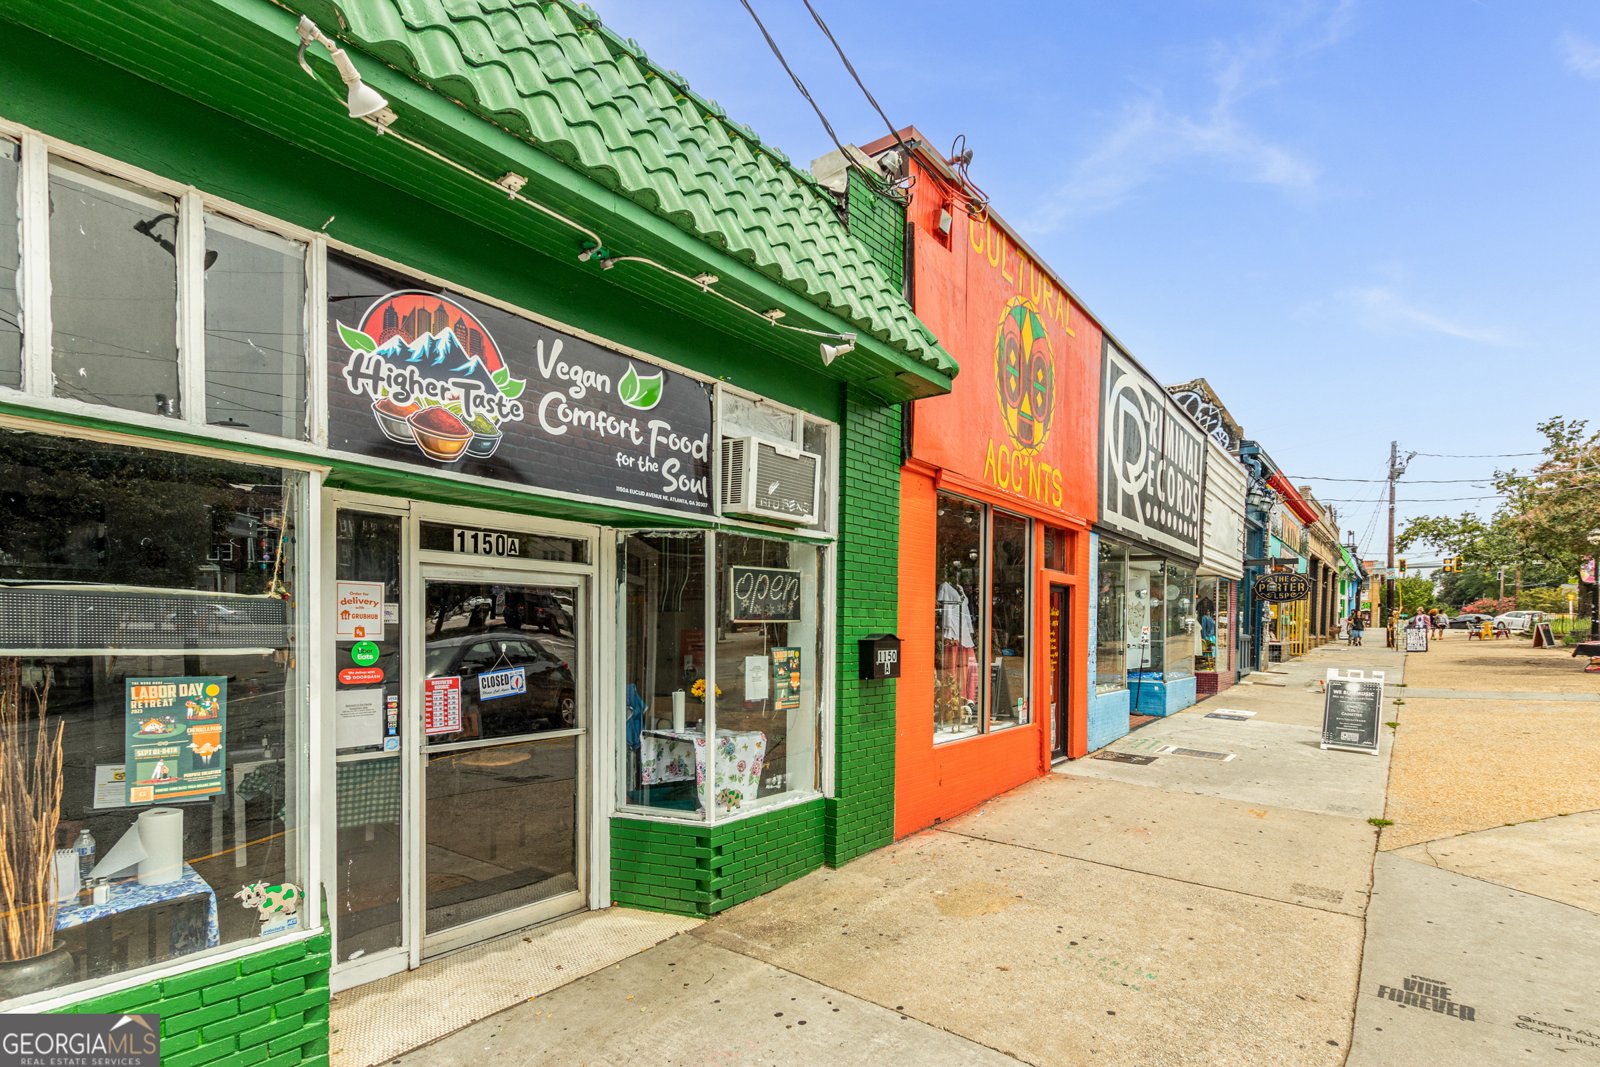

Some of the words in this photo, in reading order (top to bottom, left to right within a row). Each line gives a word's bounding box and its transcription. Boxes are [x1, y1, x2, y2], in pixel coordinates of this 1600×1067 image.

[968, 213, 1076, 338] CULTURAL
[537, 339, 611, 399] Vegan
[344, 351, 452, 404] Higher
[449, 378, 524, 421] Taste
[538, 391, 643, 445] Comfort
[648, 419, 708, 463] Food
[616, 452, 635, 467] for
[637, 456, 659, 472] the
[661, 457, 708, 498] Soul
[983, 437, 1063, 507] ACC'NTS
[629, 488, 645, 497] EUCLID
[646, 492, 662, 500] AVENUE
[670, 497, 688, 505] ATLANTA,
[340, 597, 379, 608] delivery
[735, 572, 799, 614] open
[878, 650, 898, 663] 1150
[885, 662, 891, 674] A
[130, 684, 177, 700] LABOR
[178, 682, 204, 697] DAY
[481, 673, 510, 690] CLOSED
[130, 699, 174, 709] RETREAT
[1403, 977, 1452, 1002] VIBE
[1377, 985, 1475, 1022] FOREVER
[1515, 1022, 1562, 1039] Good
[1517, 1014, 1572, 1033] Gracie
